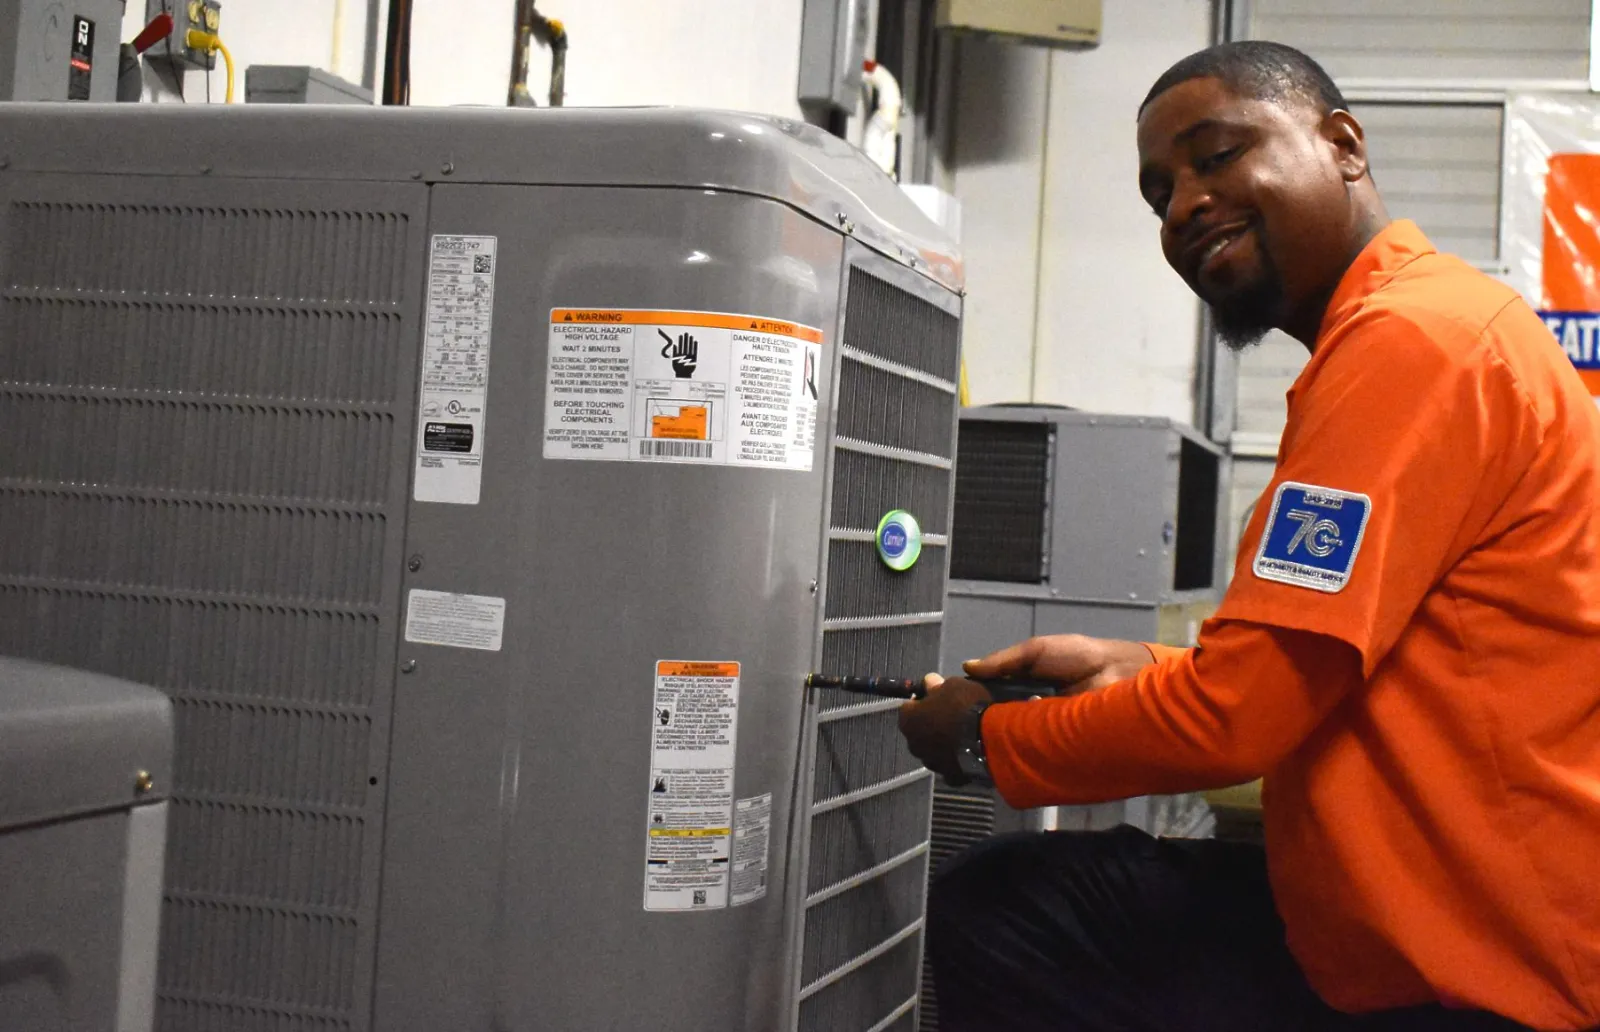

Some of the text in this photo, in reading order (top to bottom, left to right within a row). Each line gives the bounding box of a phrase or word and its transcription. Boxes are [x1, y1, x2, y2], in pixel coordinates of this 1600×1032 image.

[78, 20, 88, 46] ON
[576, 313, 622, 321] WARNING
[733, 334, 760, 342] DANGER
[1546, 317, 1600, 361] EAT
[743, 354, 773, 363] ATTENDRE
